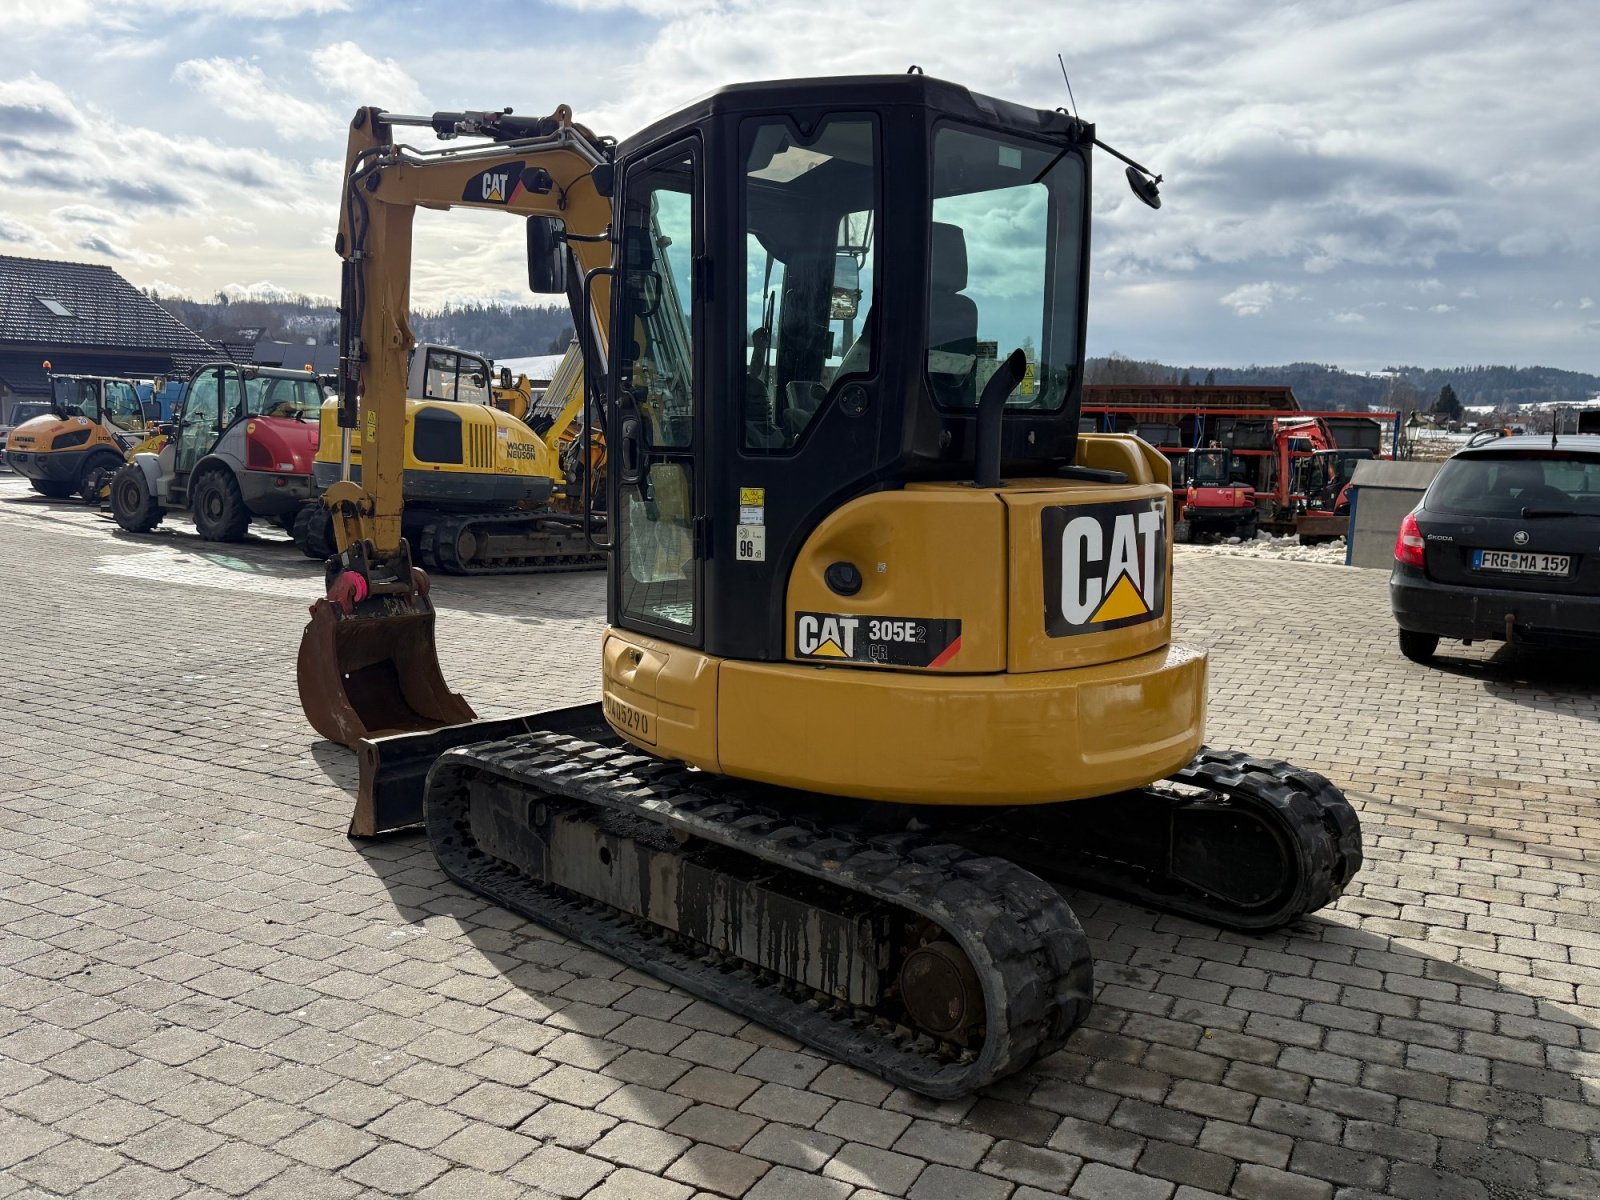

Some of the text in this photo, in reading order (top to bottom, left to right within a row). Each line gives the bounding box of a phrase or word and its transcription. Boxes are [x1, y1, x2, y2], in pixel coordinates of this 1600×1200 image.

[482, 172, 508, 201] CAT
[506, 441, 535, 452] WACKER
[506, 450, 536, 460] NEUSON
[740, 540, 753, 557] 96
[1061, 511, 1160, 625] CAT
[1482, 552, 1569, 572] FRG MA 159
[799, 615, 859, 658] CAT
[869, 620, 927, 643] 305E2
[869, 644, 888, 660] CR
